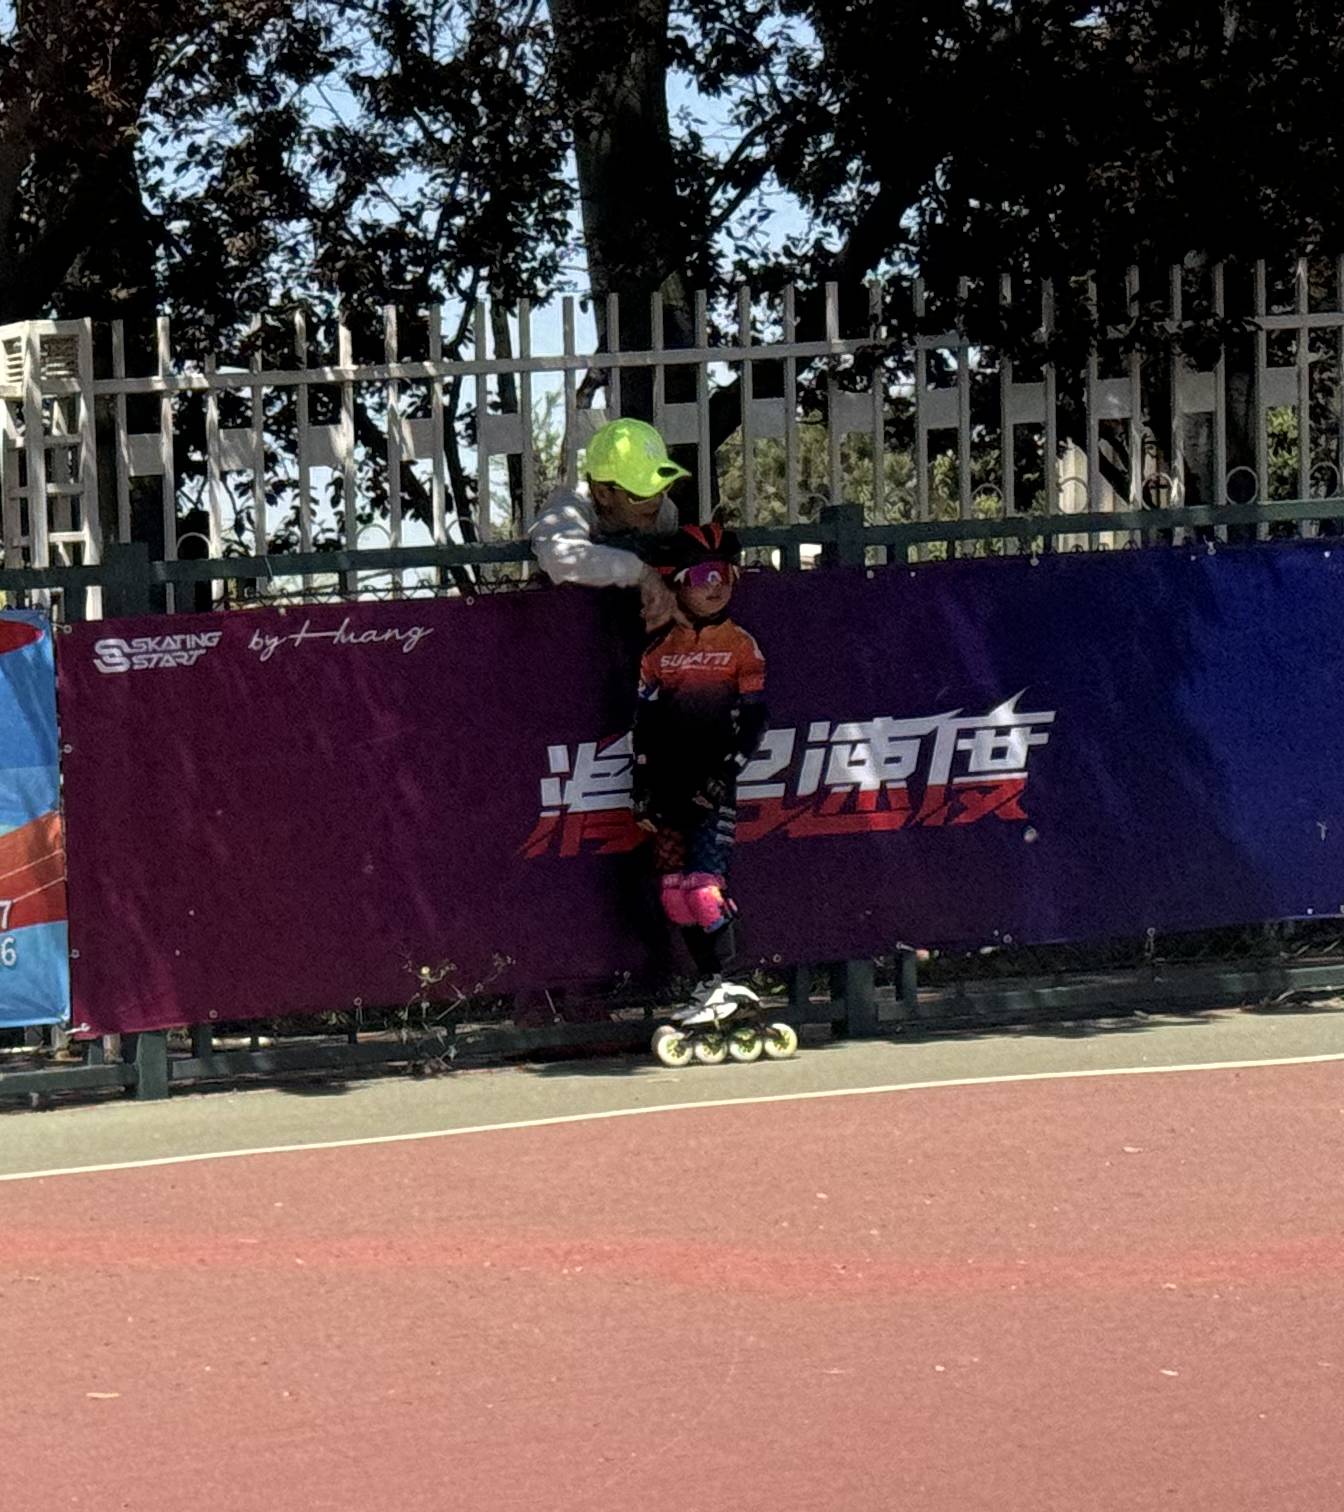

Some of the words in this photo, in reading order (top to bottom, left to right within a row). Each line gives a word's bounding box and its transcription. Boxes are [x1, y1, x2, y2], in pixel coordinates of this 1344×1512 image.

[131, 631, 223, 653] SKATING
[248, 629, 287, 661] by
[132, 649, 207, 670] START
